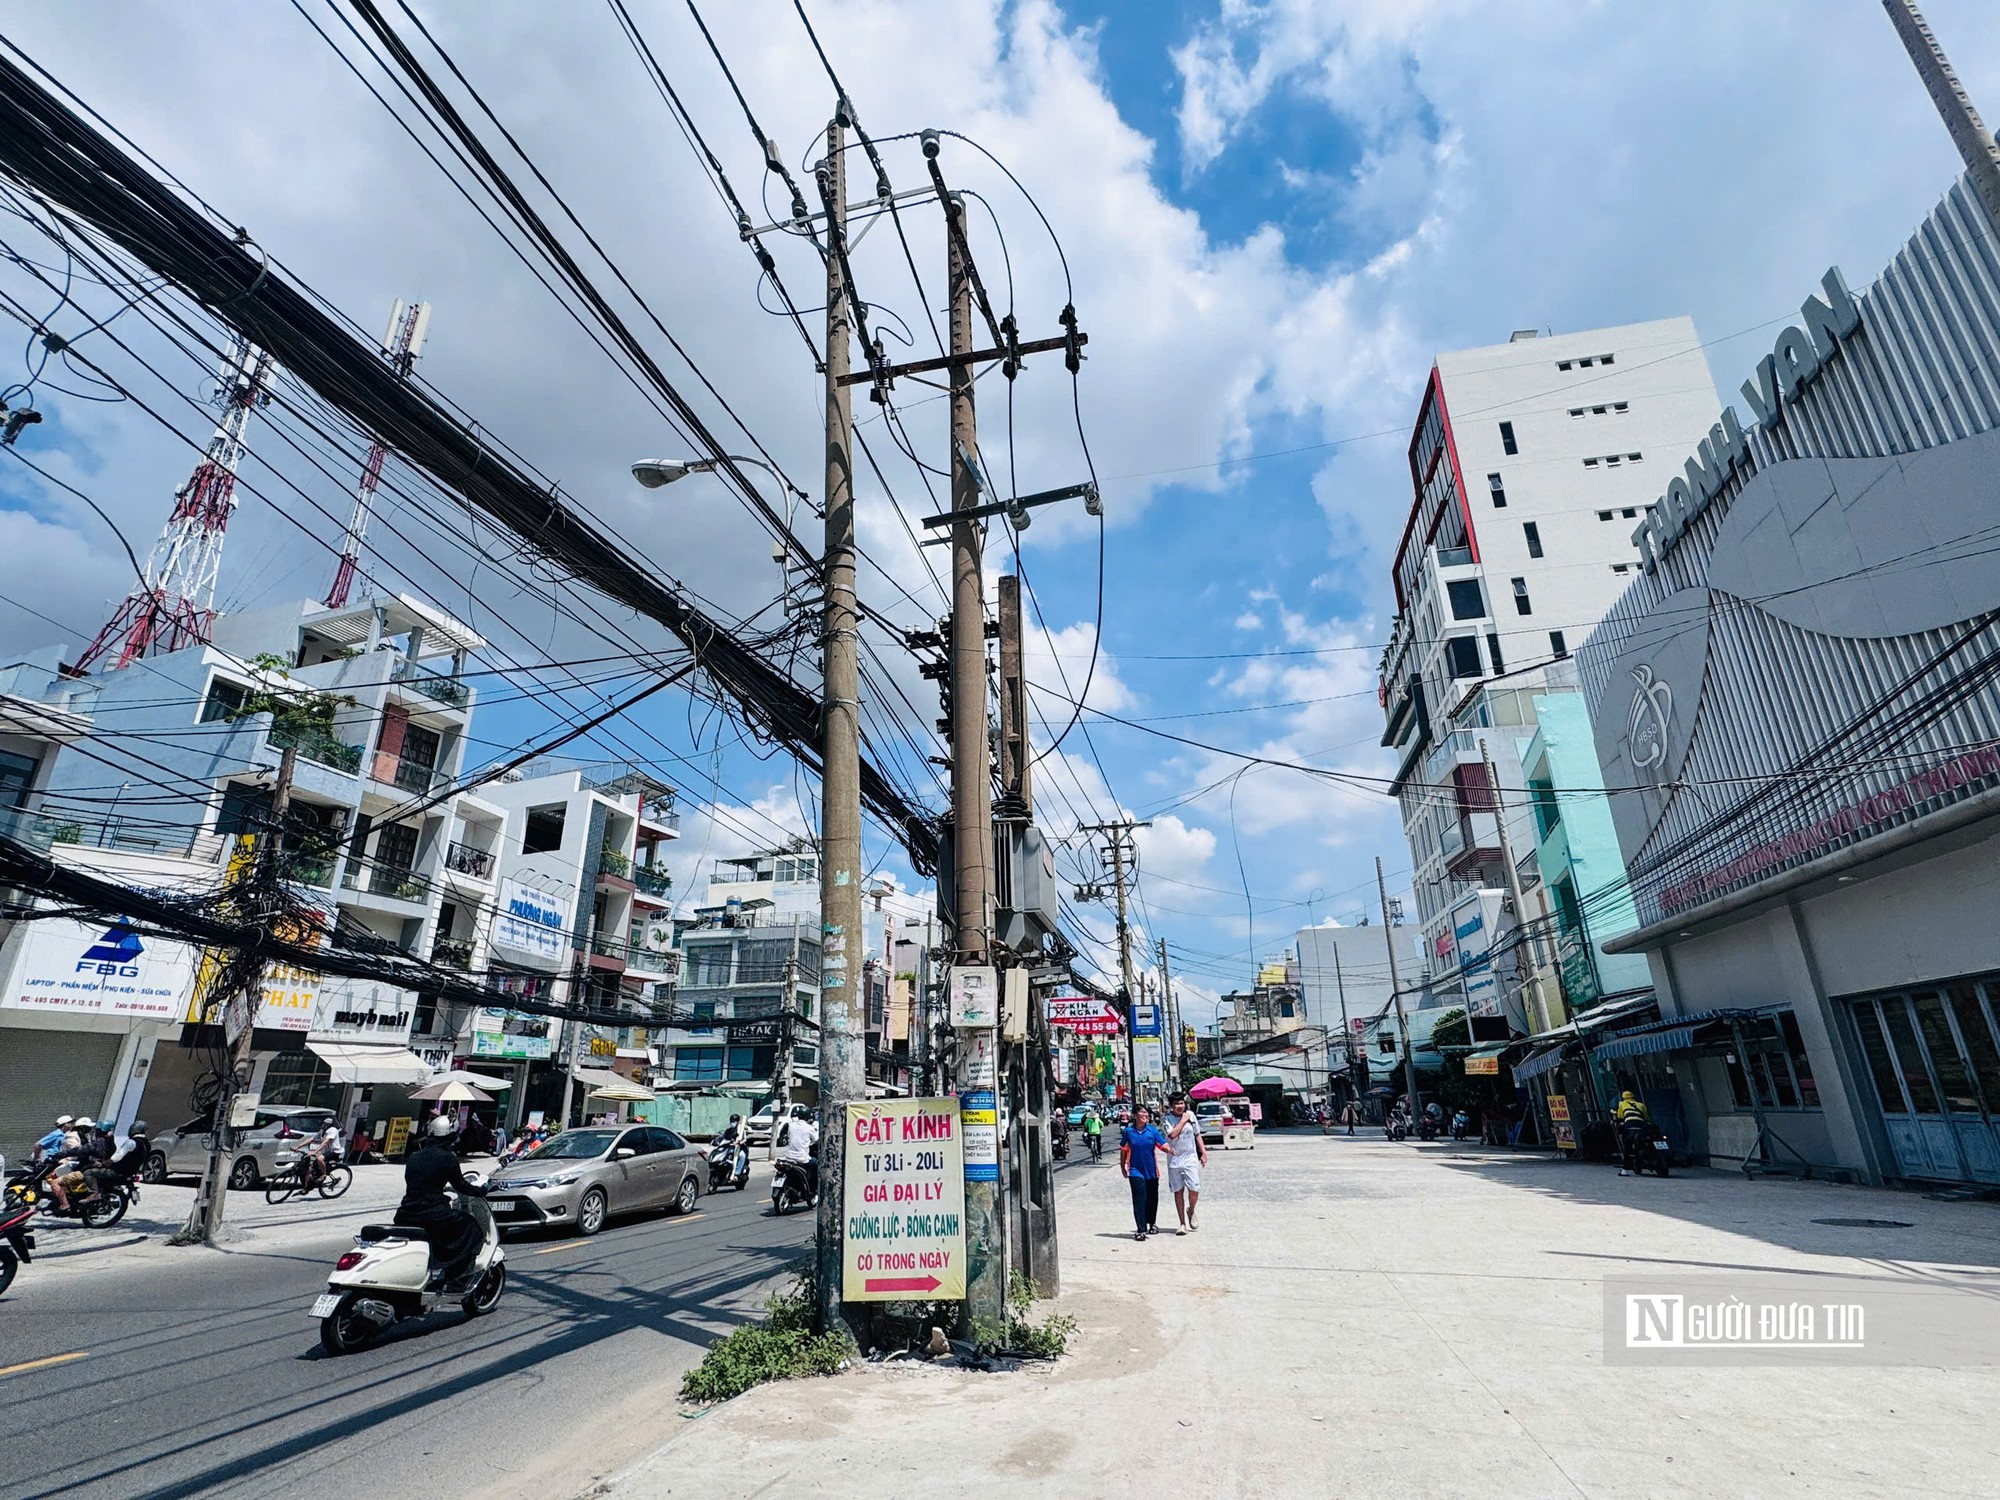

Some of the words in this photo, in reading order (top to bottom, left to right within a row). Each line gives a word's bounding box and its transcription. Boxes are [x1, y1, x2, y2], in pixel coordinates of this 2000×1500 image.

[1637, 723, 1658, 746] HBSO
[75, 961, 139, 978] FBG
[26, 978, 56, 987] LAPTOP
[377, 1010, 410, 1027] nail
[855, 1106, 895, 1143] CẮT
[902, 1108, 951, 1141] KÍNH
[864, 1153, 881, 1172] Từ
[884, 1152, 903, 1172] 3Li
[916, 1151, 944, 1171] 20Li
[863, 1179, 888, 1202] GIÁ
[894, 1182, 919, 1205] ĐẠI
[924, 1177, 943, 1201] LÝ
[849, 1210, 880, 1240] CƯỜNG
[882, 1211, 900, 1246] LỰC
[906, 1208, 932, 1238] BÓNG
[934, 1213, 959, 1244] CẠNH
[857, 1249, 873, 1271] CÓ
[877, 1252, 916, 1270] TRONG
[919, 1247, 951, 1269] NGÀY
